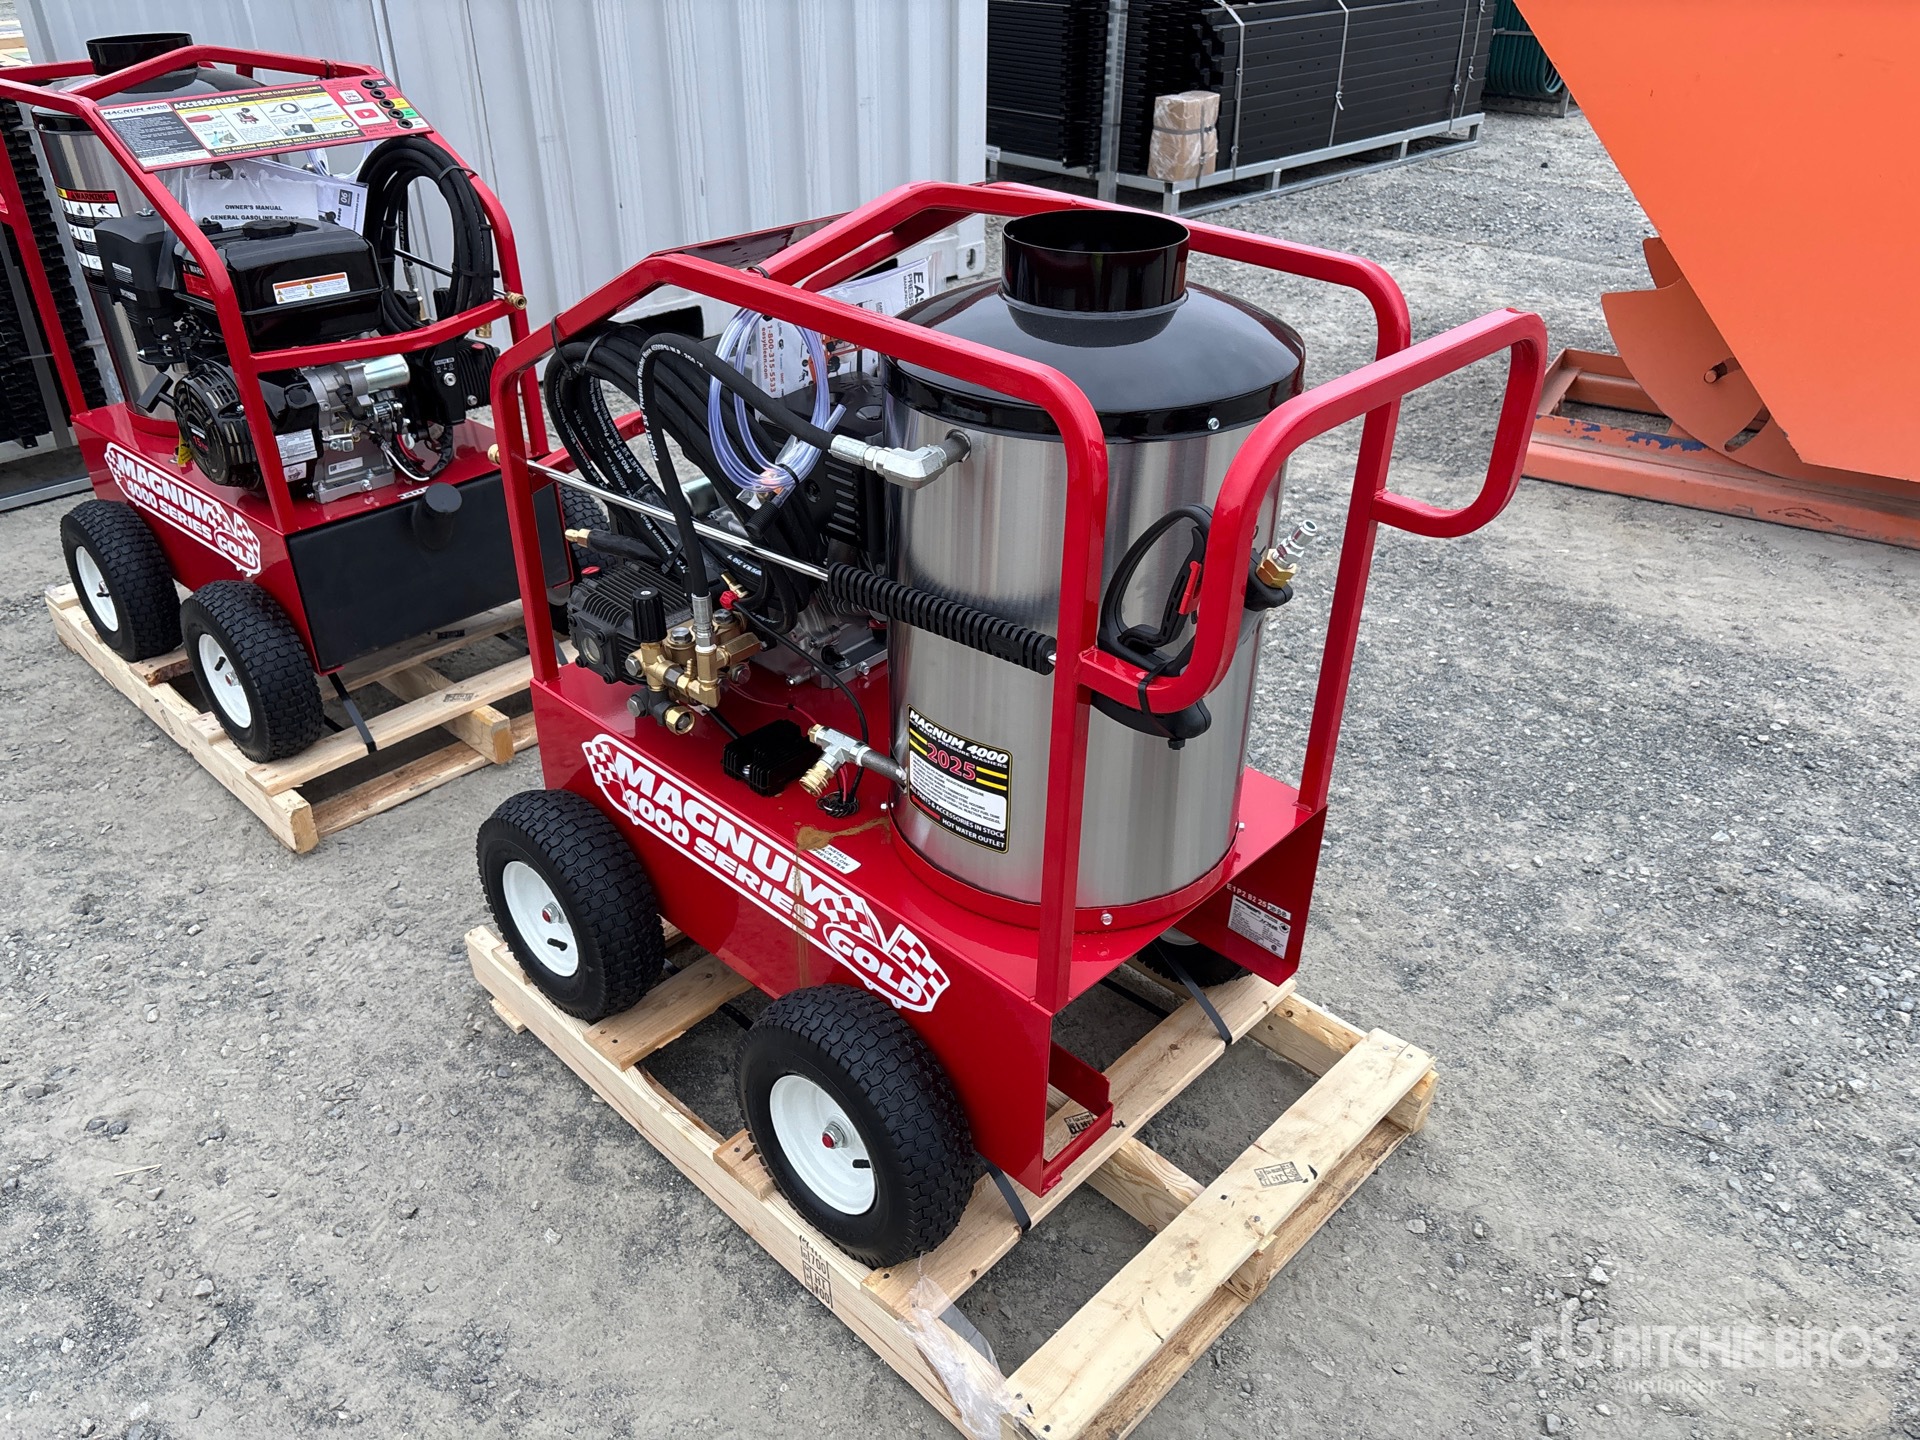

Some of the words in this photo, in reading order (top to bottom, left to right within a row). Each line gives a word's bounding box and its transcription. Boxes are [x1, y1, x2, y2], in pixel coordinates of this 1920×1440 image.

[103, 107, 144, 116] MAGNUM
[174, 96, 240, 110] ACCESSORIES
[767, 324, 776, 393] 1-800-315-5533
[638, 378, 646, 410] Pressure
[597, 412, 610, 437] Pressure
[614, 450, 632, 474] PROJET
[644, 428, 660, 462] PROJET
[628, 458, 648, 482] PROJET
[117, 453, 215, 522] MAGNUM
[126, 482, 158, 510] 4000
[160, 502, 213, 541] SERIES
[219, 534, 256, 568] GOLD
[652, 529, 674, 555] Pressure
[910, 710, 966, 750] MAGNUM
[966, 744, 1008, 764] 4000
[919, 727, 937, 740] WATER
[938, 738, 970, 759] PRESSURE
[970, 754, 1008, 769] WASHERS
[926, 742, 976, 781] 2025
[910, 784, 918, 794] ALL
[916, 792, 932, 806] PARTS
[936, 804, 974, 828] ACCESSORIES
[974, 823, 982, 831] IN
[982, 825, 1005, 838] STOCK
[614, 751, 832, 913] MAGNUM
[942, 818, 955, 829] HOT
[955, 826, 977, 840] WATER
[978, 834, 1005, 848] OUTLET
[623, 790, 690, 845] 4000
[694, 837, 819, 930] SERIES
[829, 930, 923, 1003] GOLD
[814, 1273, 826, 1290] HT
